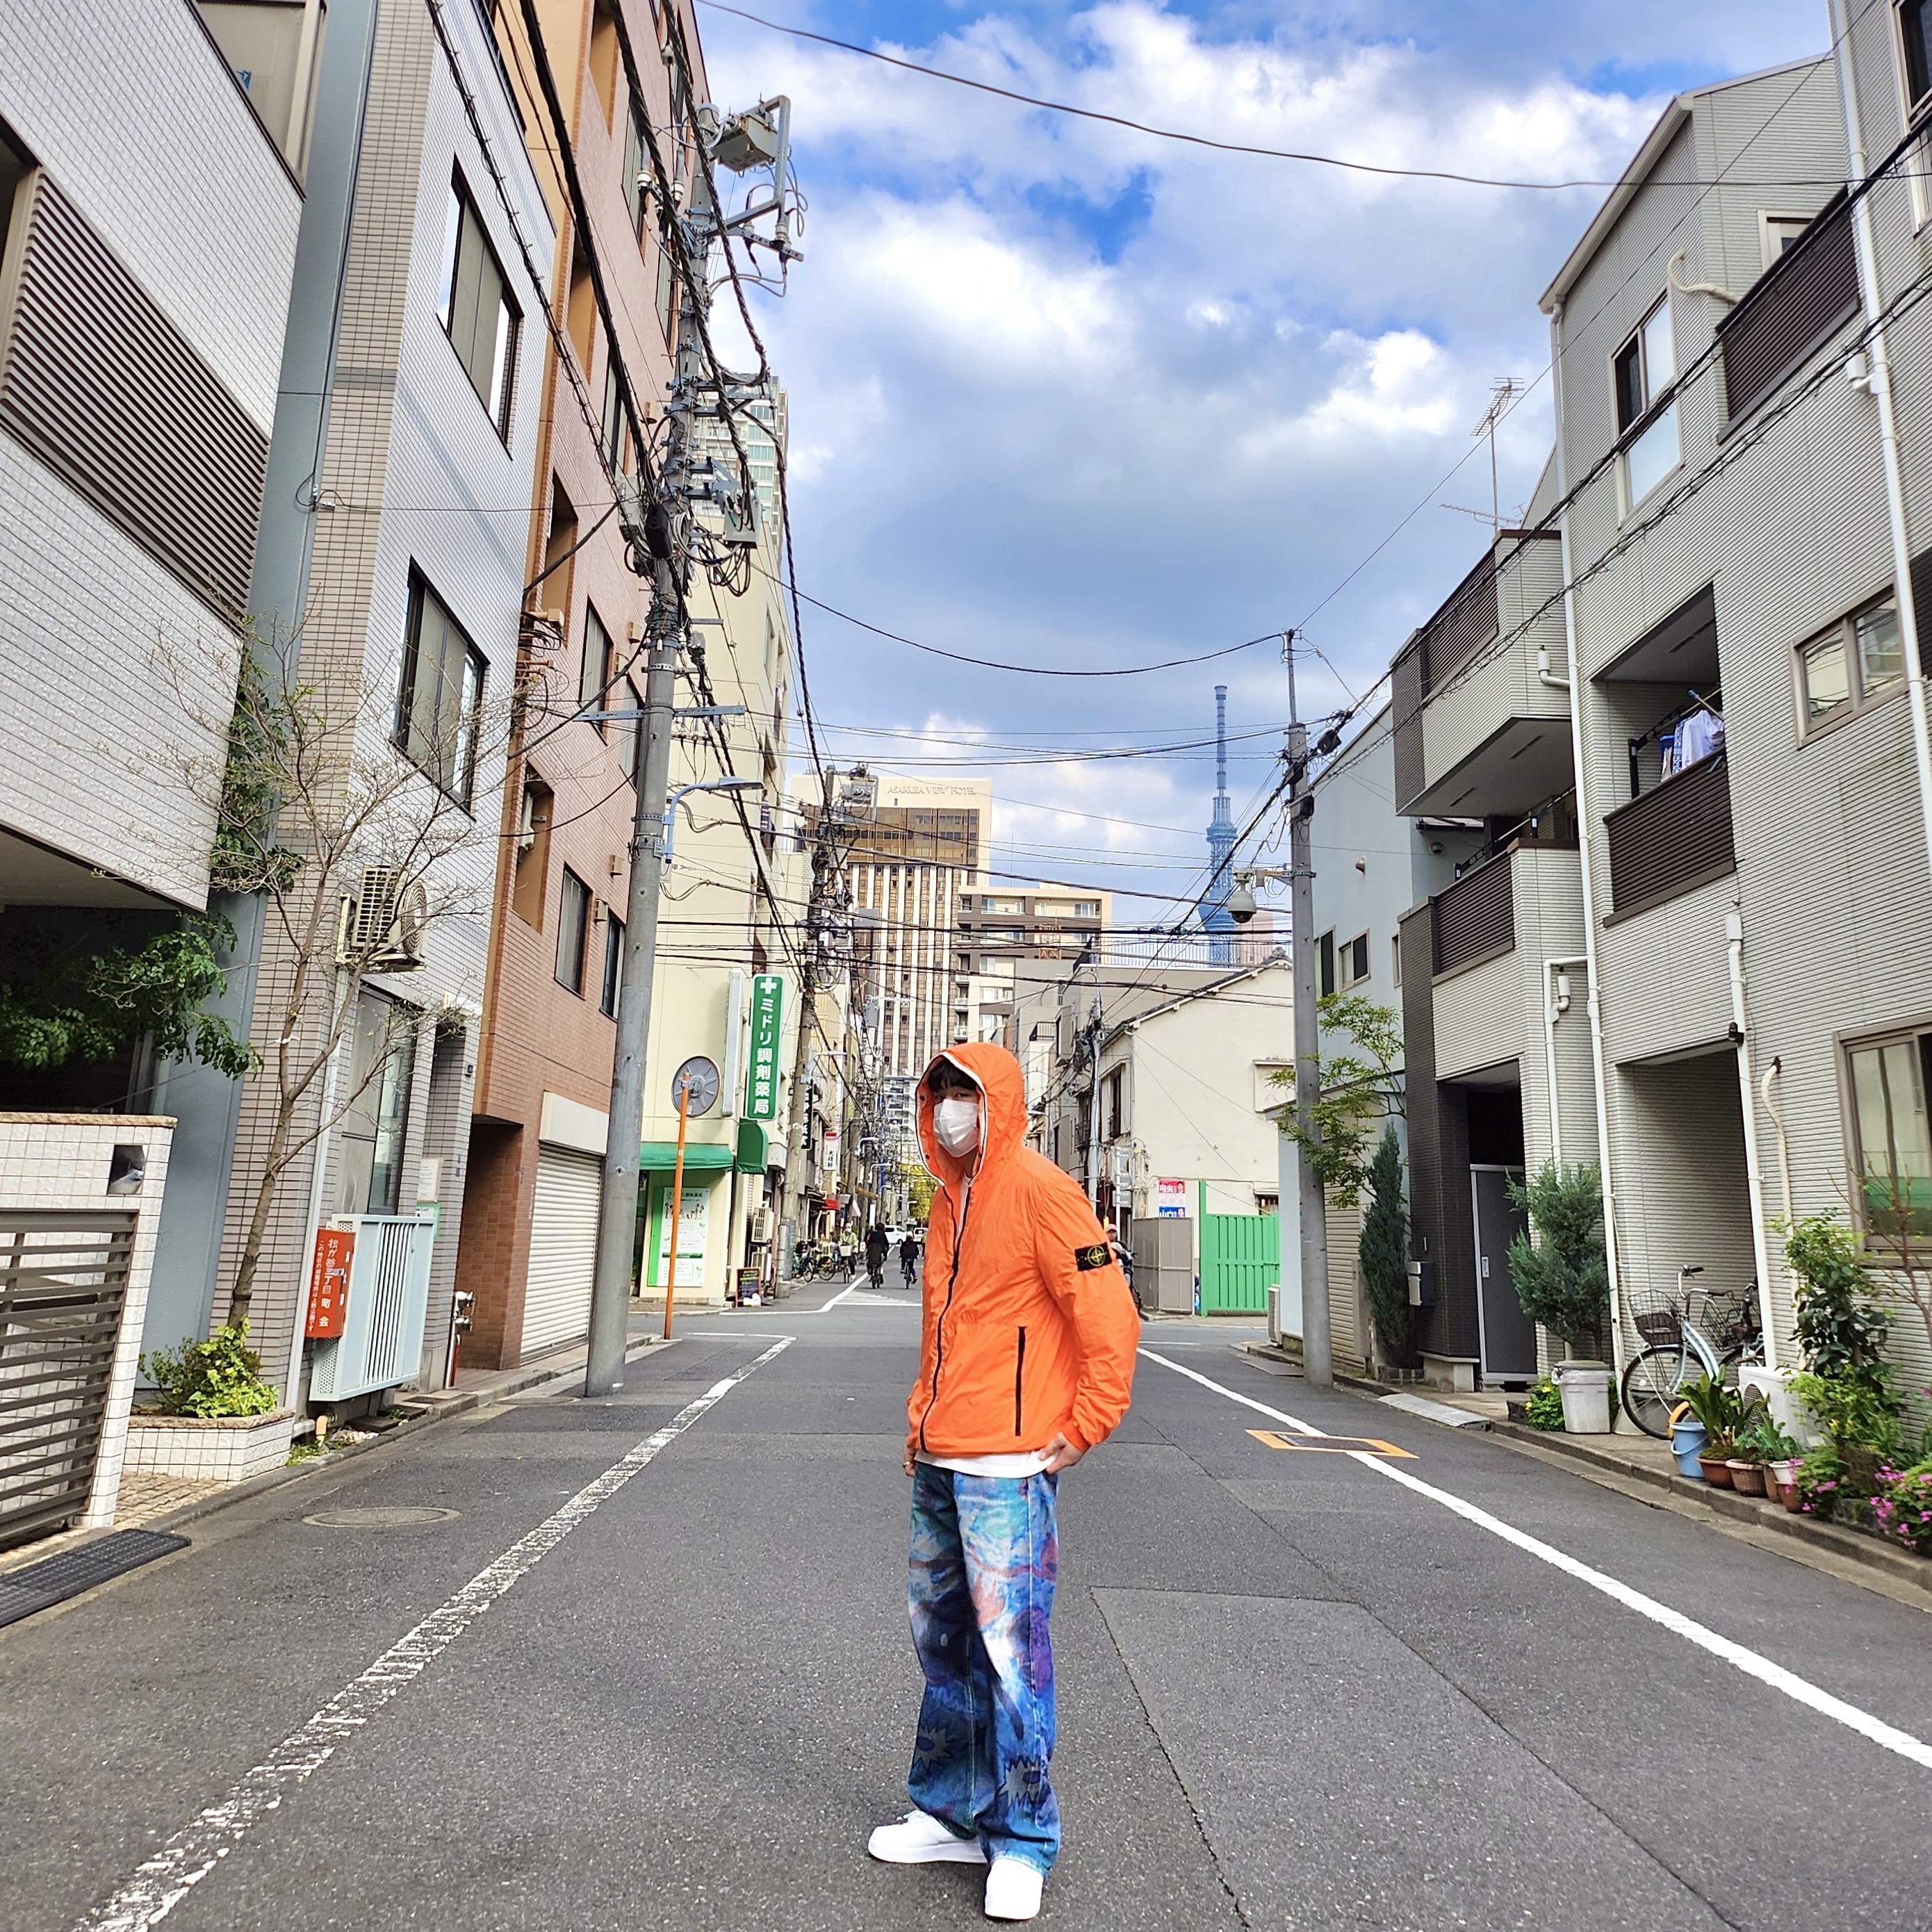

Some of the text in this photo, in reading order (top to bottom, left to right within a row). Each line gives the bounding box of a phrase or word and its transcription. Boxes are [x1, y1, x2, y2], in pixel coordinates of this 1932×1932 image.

[887, 786, 976, 795] ASAKUSA VIEW HOTEL
[753, 998, 773, 1115] ミドリ調剤薬局
[1159, 1184, 1174, 1193] 弓矢
